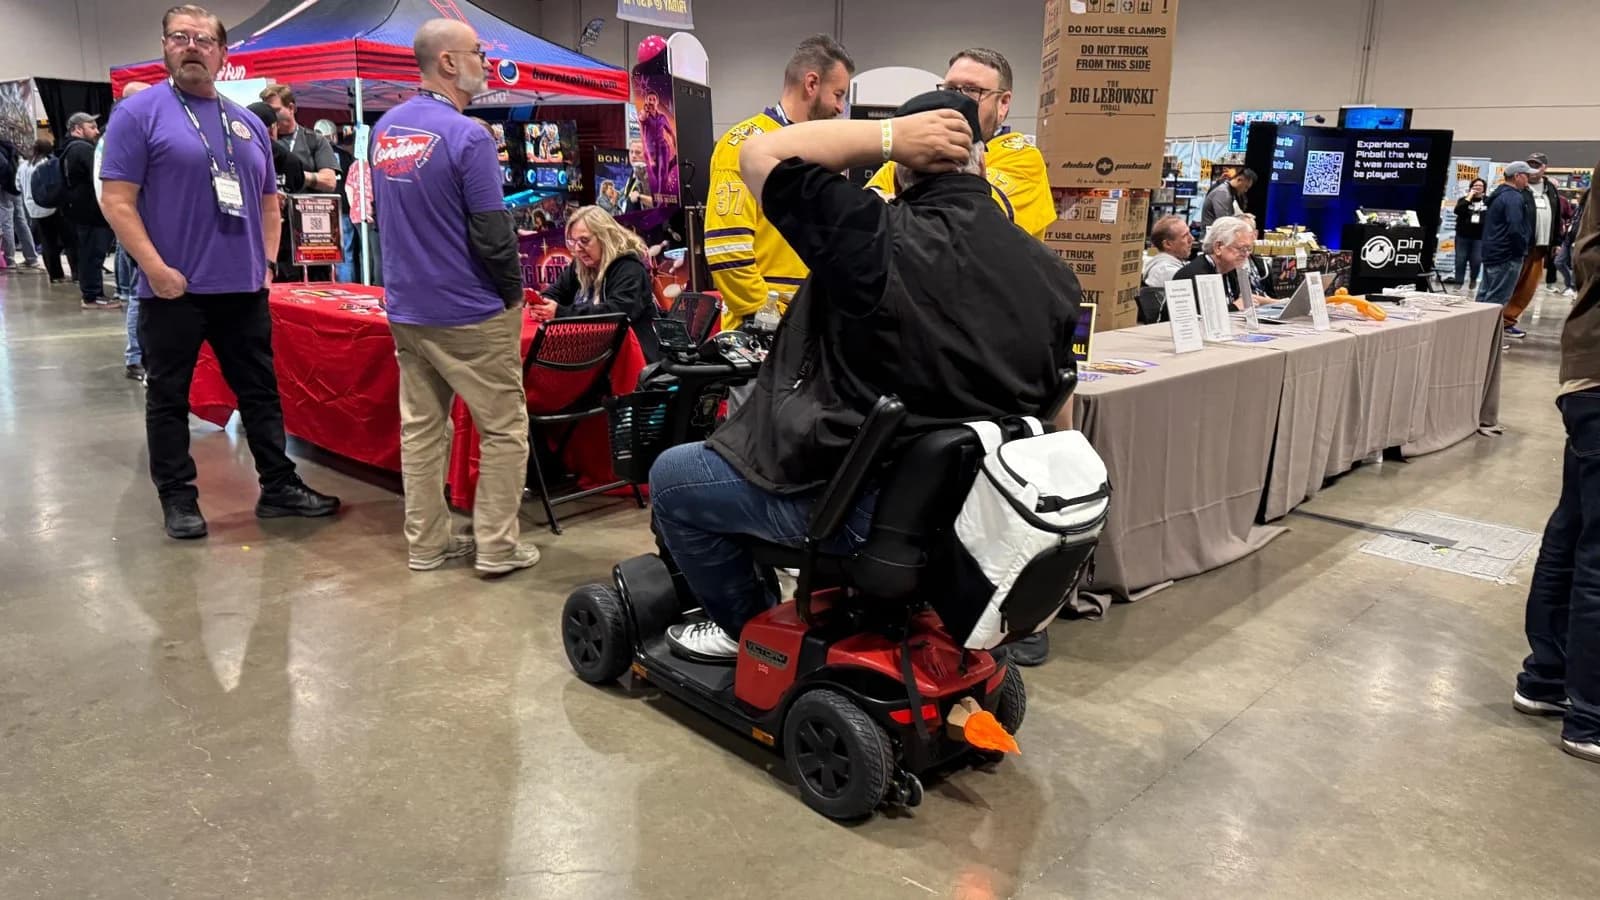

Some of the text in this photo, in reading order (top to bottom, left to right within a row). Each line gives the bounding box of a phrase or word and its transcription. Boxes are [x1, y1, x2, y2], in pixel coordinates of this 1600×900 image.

[1068, 25, 1167, 35] DO NOT USE CLAMPS
[1081, 44, 1148, 55] DO NOT TRUCK
[1076, 59, 1151, 69] FROM THIS SIDE
[1069, 87, 1090, 103] BIG
[1357, 140, 1409, 149] Experience
[597, 155, 620, 163] BON
[1356, 150, 1428, 160] Pinball the way
[1384, 161, 1414, 169] meant
[1416, 161, 1427, 169] to
[1353, 170, 1400, 180] be played.
[715, 182, 747, 216] 37
[1055, 232, 1073, 240] USE
[1075, 232, 1112, 241] CLAMPS
[1397, 237, 1423, 252] pin
[1064, 249, 1094, 260] TRUCK
[1394, 252, 1422, 266] pal
[1076, 263, 1097, 273] SIDE
